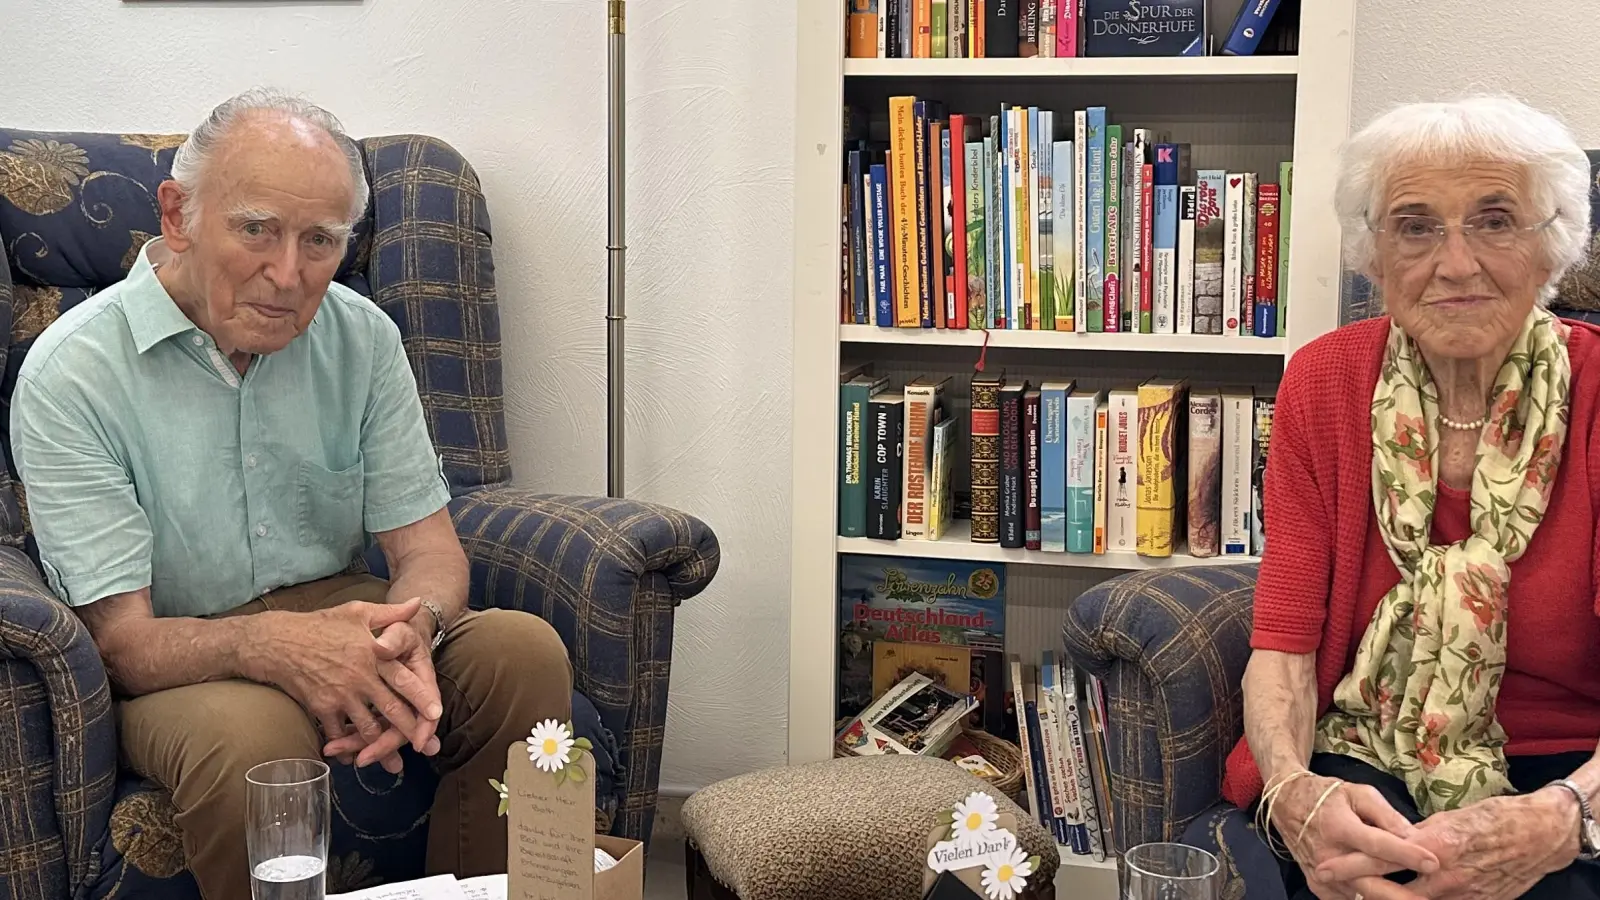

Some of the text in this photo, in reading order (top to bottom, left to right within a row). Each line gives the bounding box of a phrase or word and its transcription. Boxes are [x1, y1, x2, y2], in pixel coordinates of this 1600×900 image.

[1027, 2, 1036, 43] BERLING
[1104, 0, 1195, 21] DIE SPUR DER
[1093, 19, 1195, 36] DONNERHUFE
[897, 105, 905, 124] Mein
[898, 127, 906, 151] dickes
[916, 116, 924, 171] Einschlaf-Lieder
[1108, 137, 1116, 159] Jahr
[899, 153, 907, 178] buntes
[1158, 148, 1173, 163] K
[969, 149, 978, 191] Kinderbibel
[899, 181, 907, 200] Buch
[1088, 147, 1103, 234] Guten Tag, Elefant!
[1108, 180, 1117, 202] rund
[1187, 194, 1195, 218] PIPER
[1197, 180, 1209, 227] Die rote
[1207, 188, 1220, 218] Zora
[919, 228, 927, 265] Gute-Nacht
[1107, 206, 1116, 266] Bastel-ABC
[920, 266, 928, 299] schönsten
[1118, 411, 1127, 430] JONES
[877, 412, 887, 464] COP TOWN
[1118, 431, 1127, 453] BRIDGET
[907, 401, 926, 524] DER ROSTENDE RUHM
[881, 468, 889, 510] SLAUGHTER
[1029, 479, 1037, 497] sagst
[1143, 486, 1151, 504] Jonas
[1029, 498, 1036, 508] Du
[876, 568, 967, 604] Löwenzahn
[853, 603, 994, 628] Deutschland-
[885, 624, 941, 643] Atlas
[517, 789, 577, 806] Lieber Herr
[934, 837, 1011, 864] Vielen Dank
